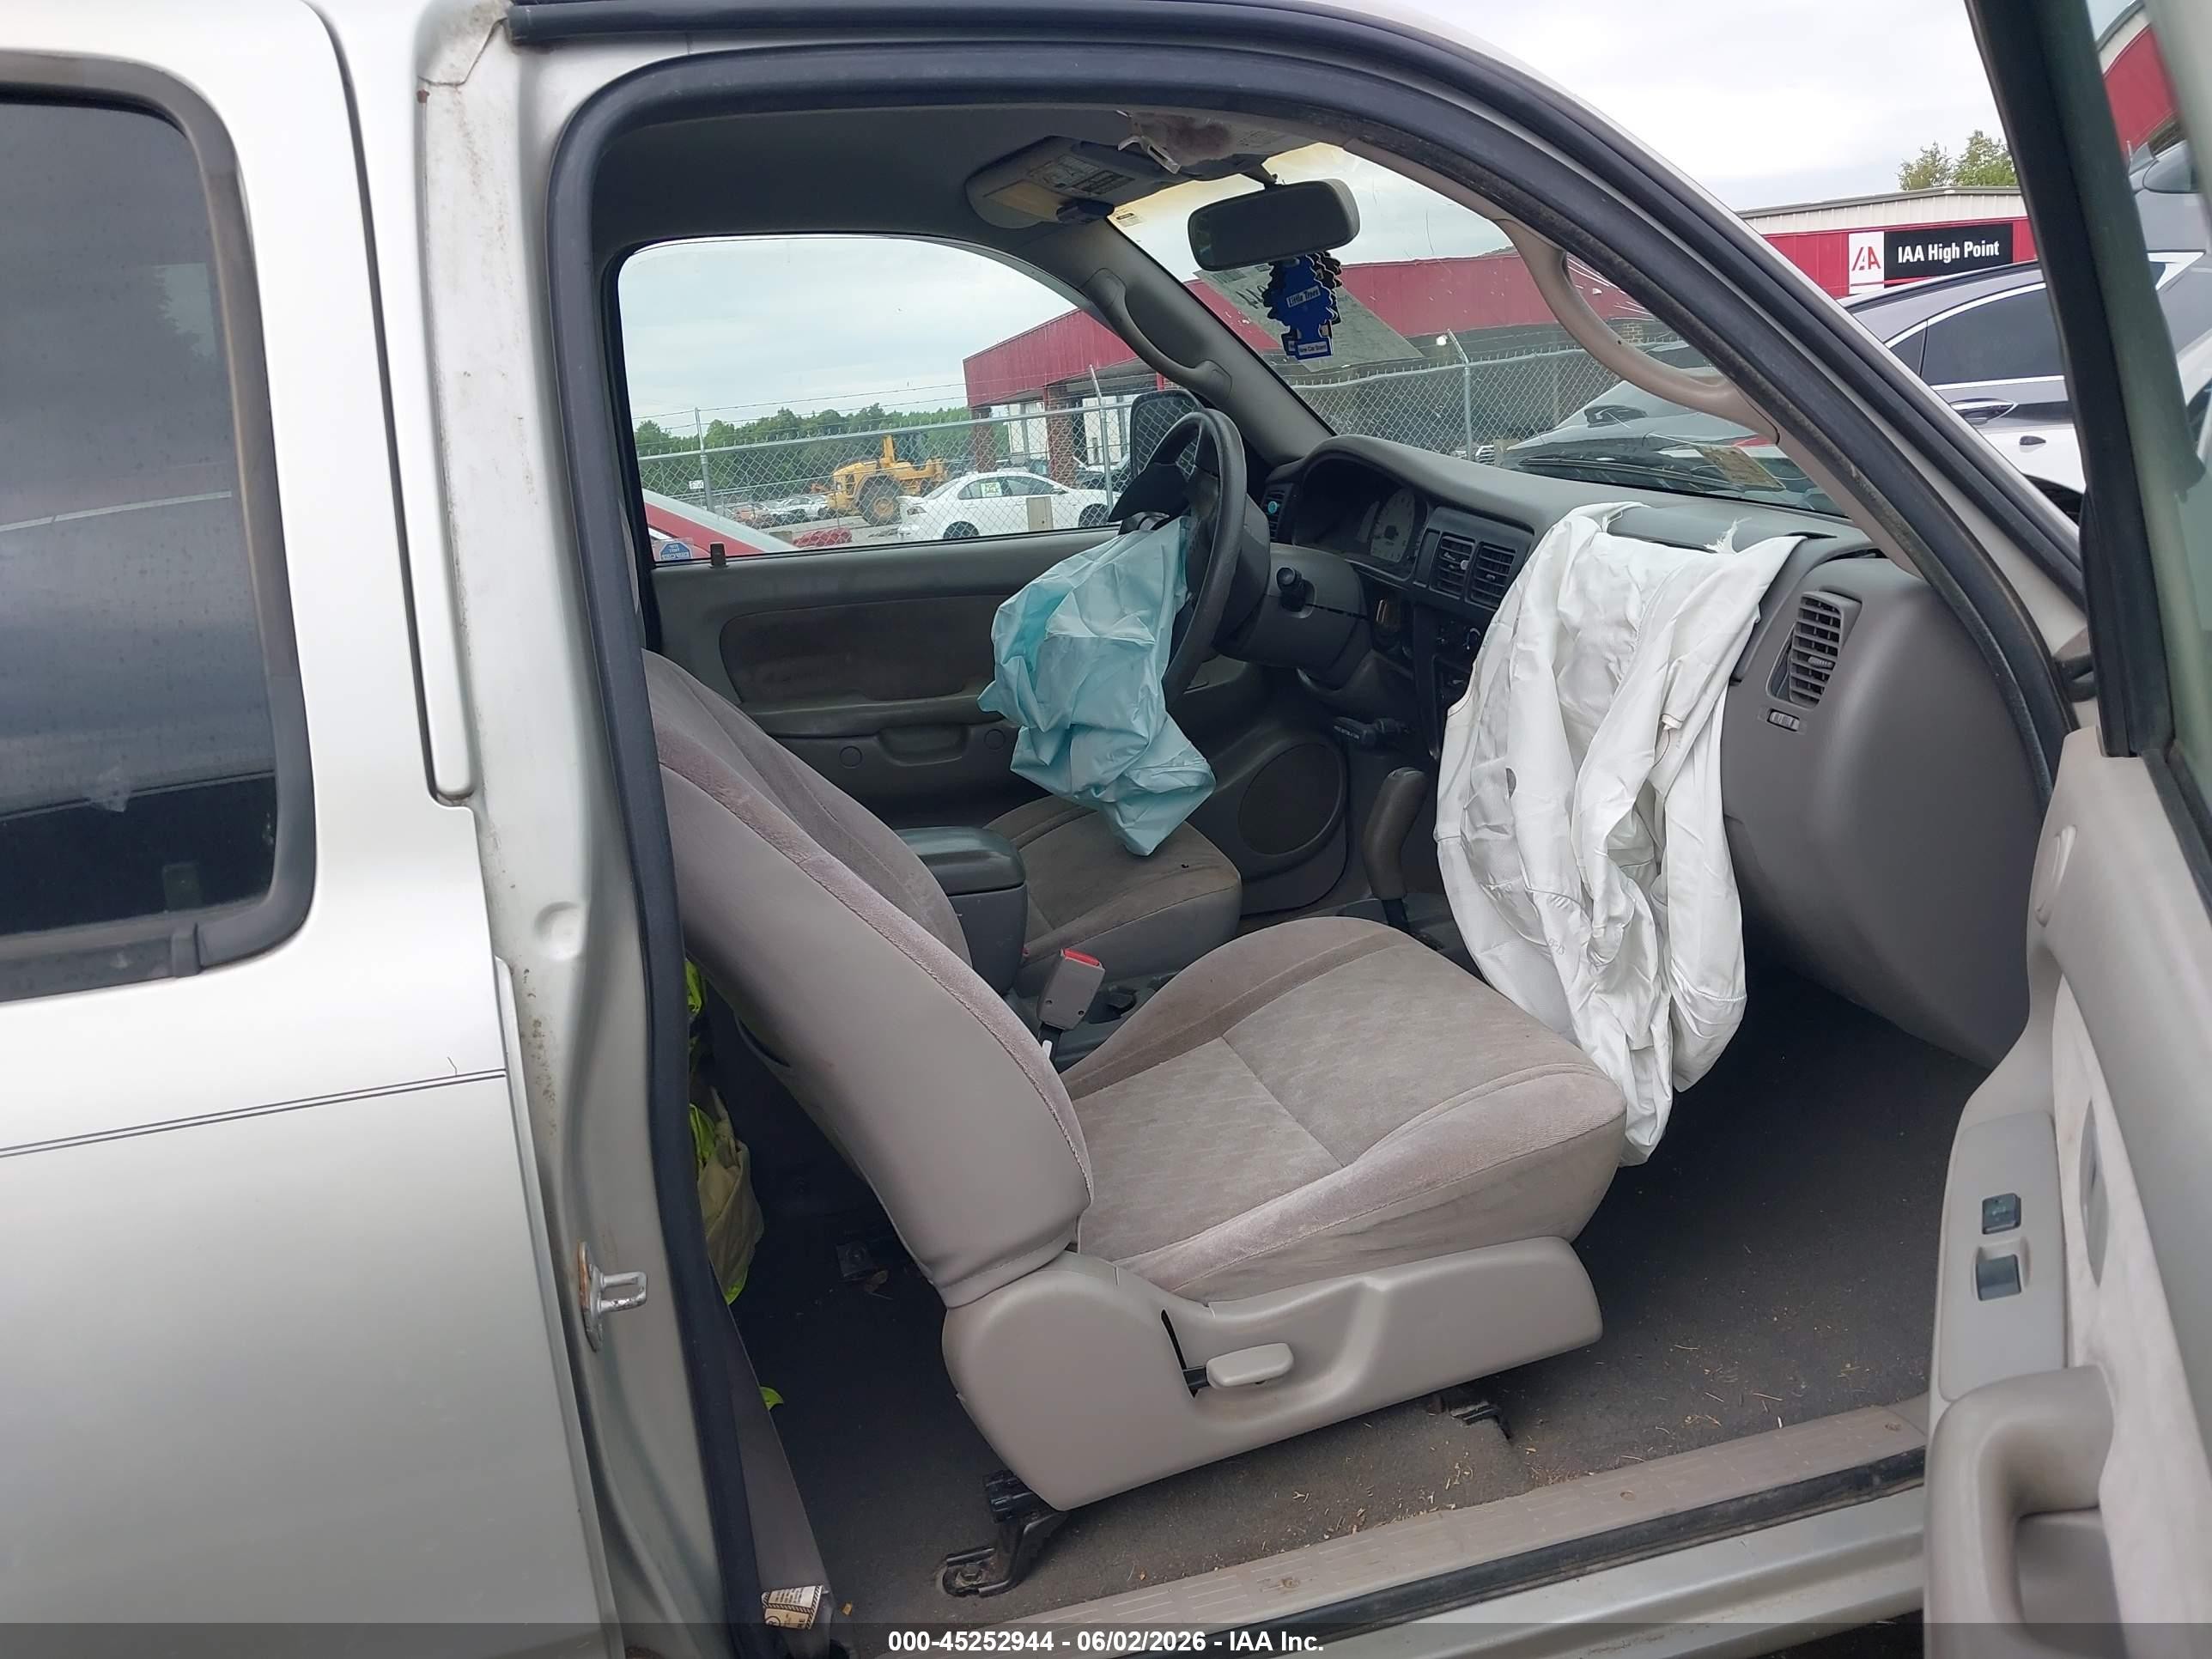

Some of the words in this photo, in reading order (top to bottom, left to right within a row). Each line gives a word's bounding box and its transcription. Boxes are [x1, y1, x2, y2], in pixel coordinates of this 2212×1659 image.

[1898, 245, 1925, 264] IAA
[1928, 242, 1960, 264] High
[1964, 240, 2000, 258] Point
